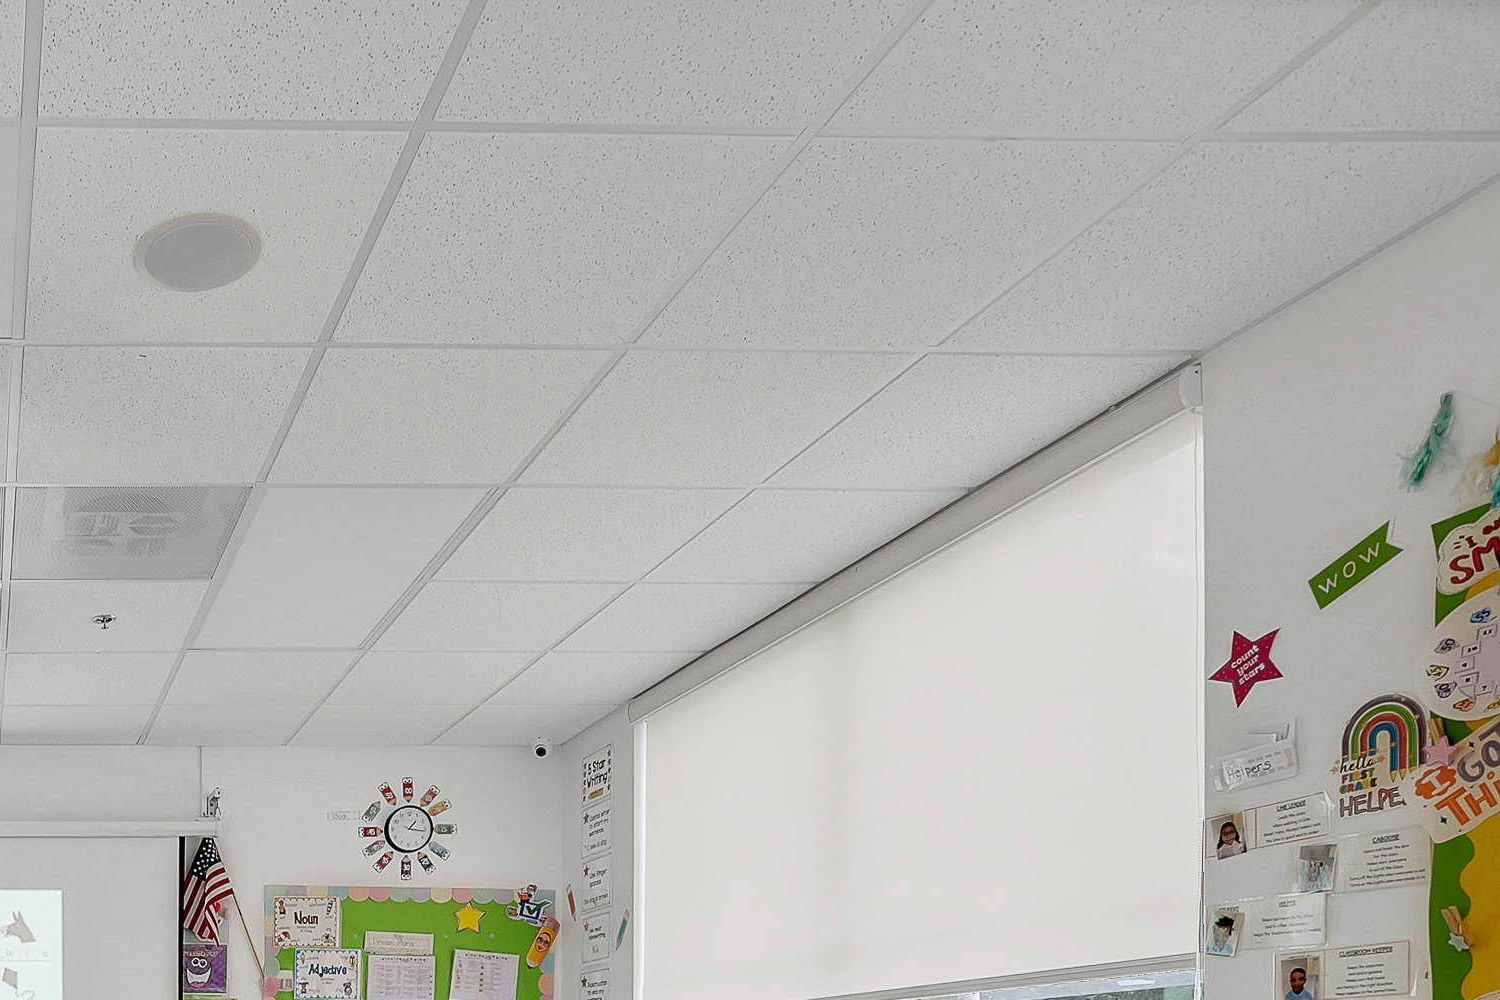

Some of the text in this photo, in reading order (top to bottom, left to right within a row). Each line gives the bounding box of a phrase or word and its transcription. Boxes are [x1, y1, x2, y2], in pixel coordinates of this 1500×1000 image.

[1317, 542, 1381, 595] WOW
[1230, 644, 1260, 670] count
[1235, 653, 1260, 677] your
[1238, 662, 1266, 686] stars
[1226, 759, 1272, 786] Helpers
[1339, 753, 1375, 774] hello
[1339, 777, 1377, 794] GRADE
[1341, 767, 1376, 785] FIRST
[1338, 786, 1407, 818] HELPE
[294, 911, 319, 926] Noun
[308, 963, 347, 979] Adjective
